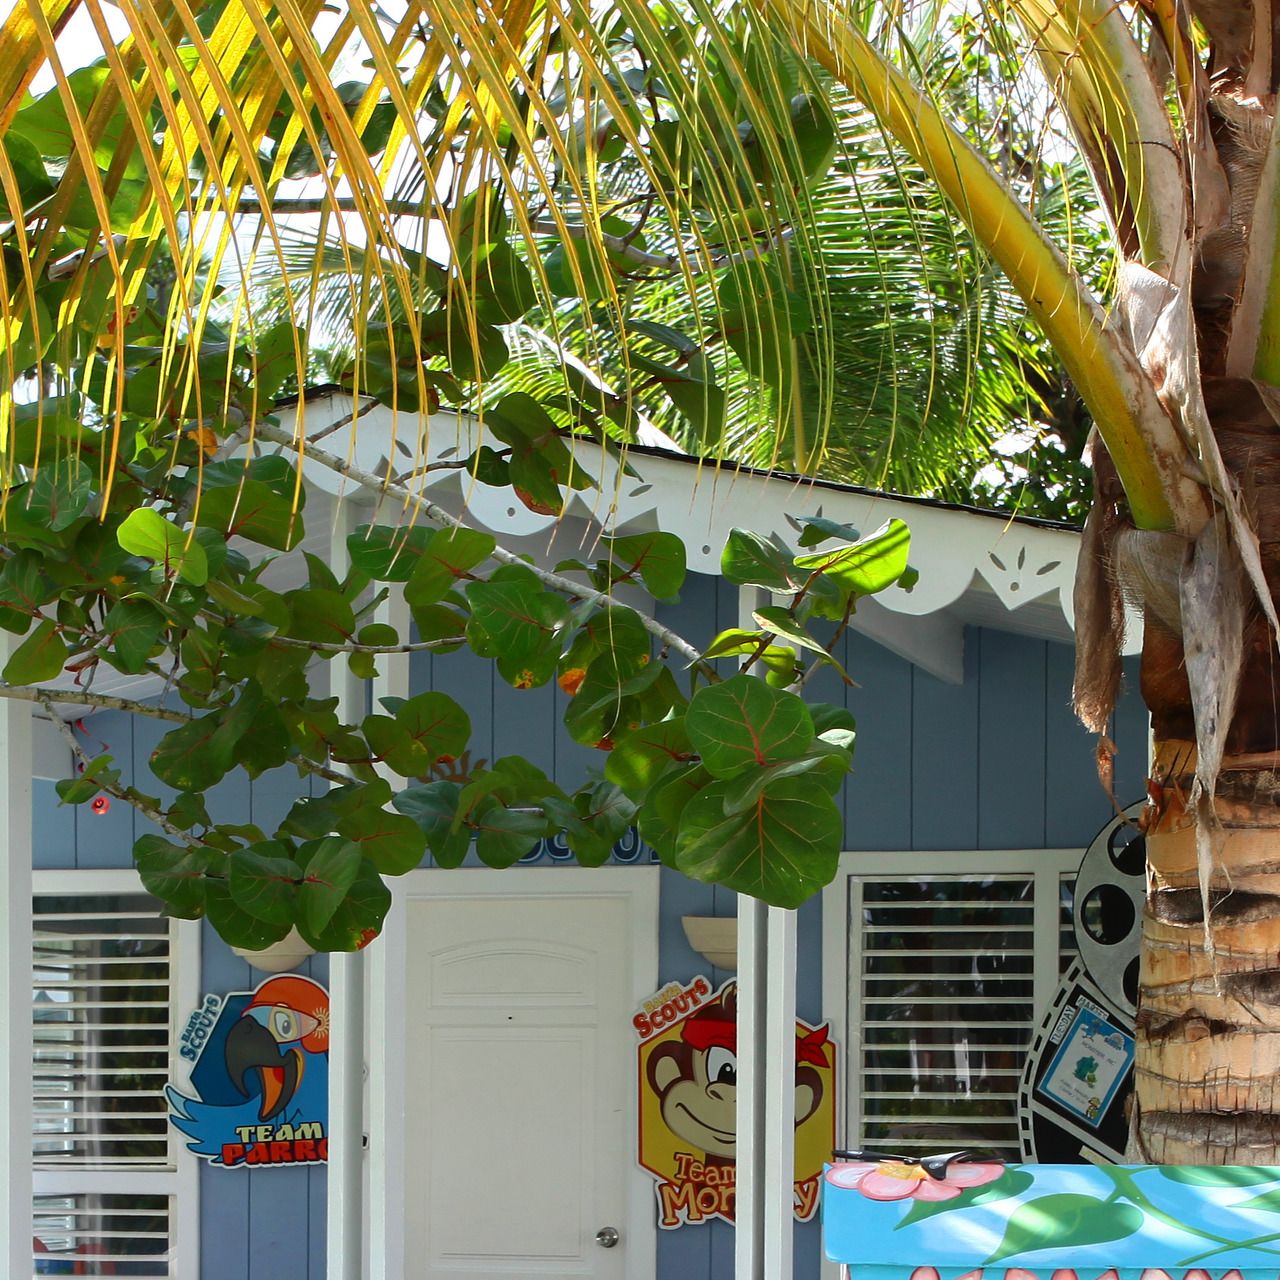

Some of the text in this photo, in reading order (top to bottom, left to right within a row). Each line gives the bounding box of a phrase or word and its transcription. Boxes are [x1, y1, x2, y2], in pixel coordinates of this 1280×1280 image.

[180, 996, 219, 1062] SCOUTS
[633, 978, 709, 1038] SCOUTS
[1052, 1006, 1075, 1044] TUESDAY
[235, 1122, 323, 1143] TEAM
